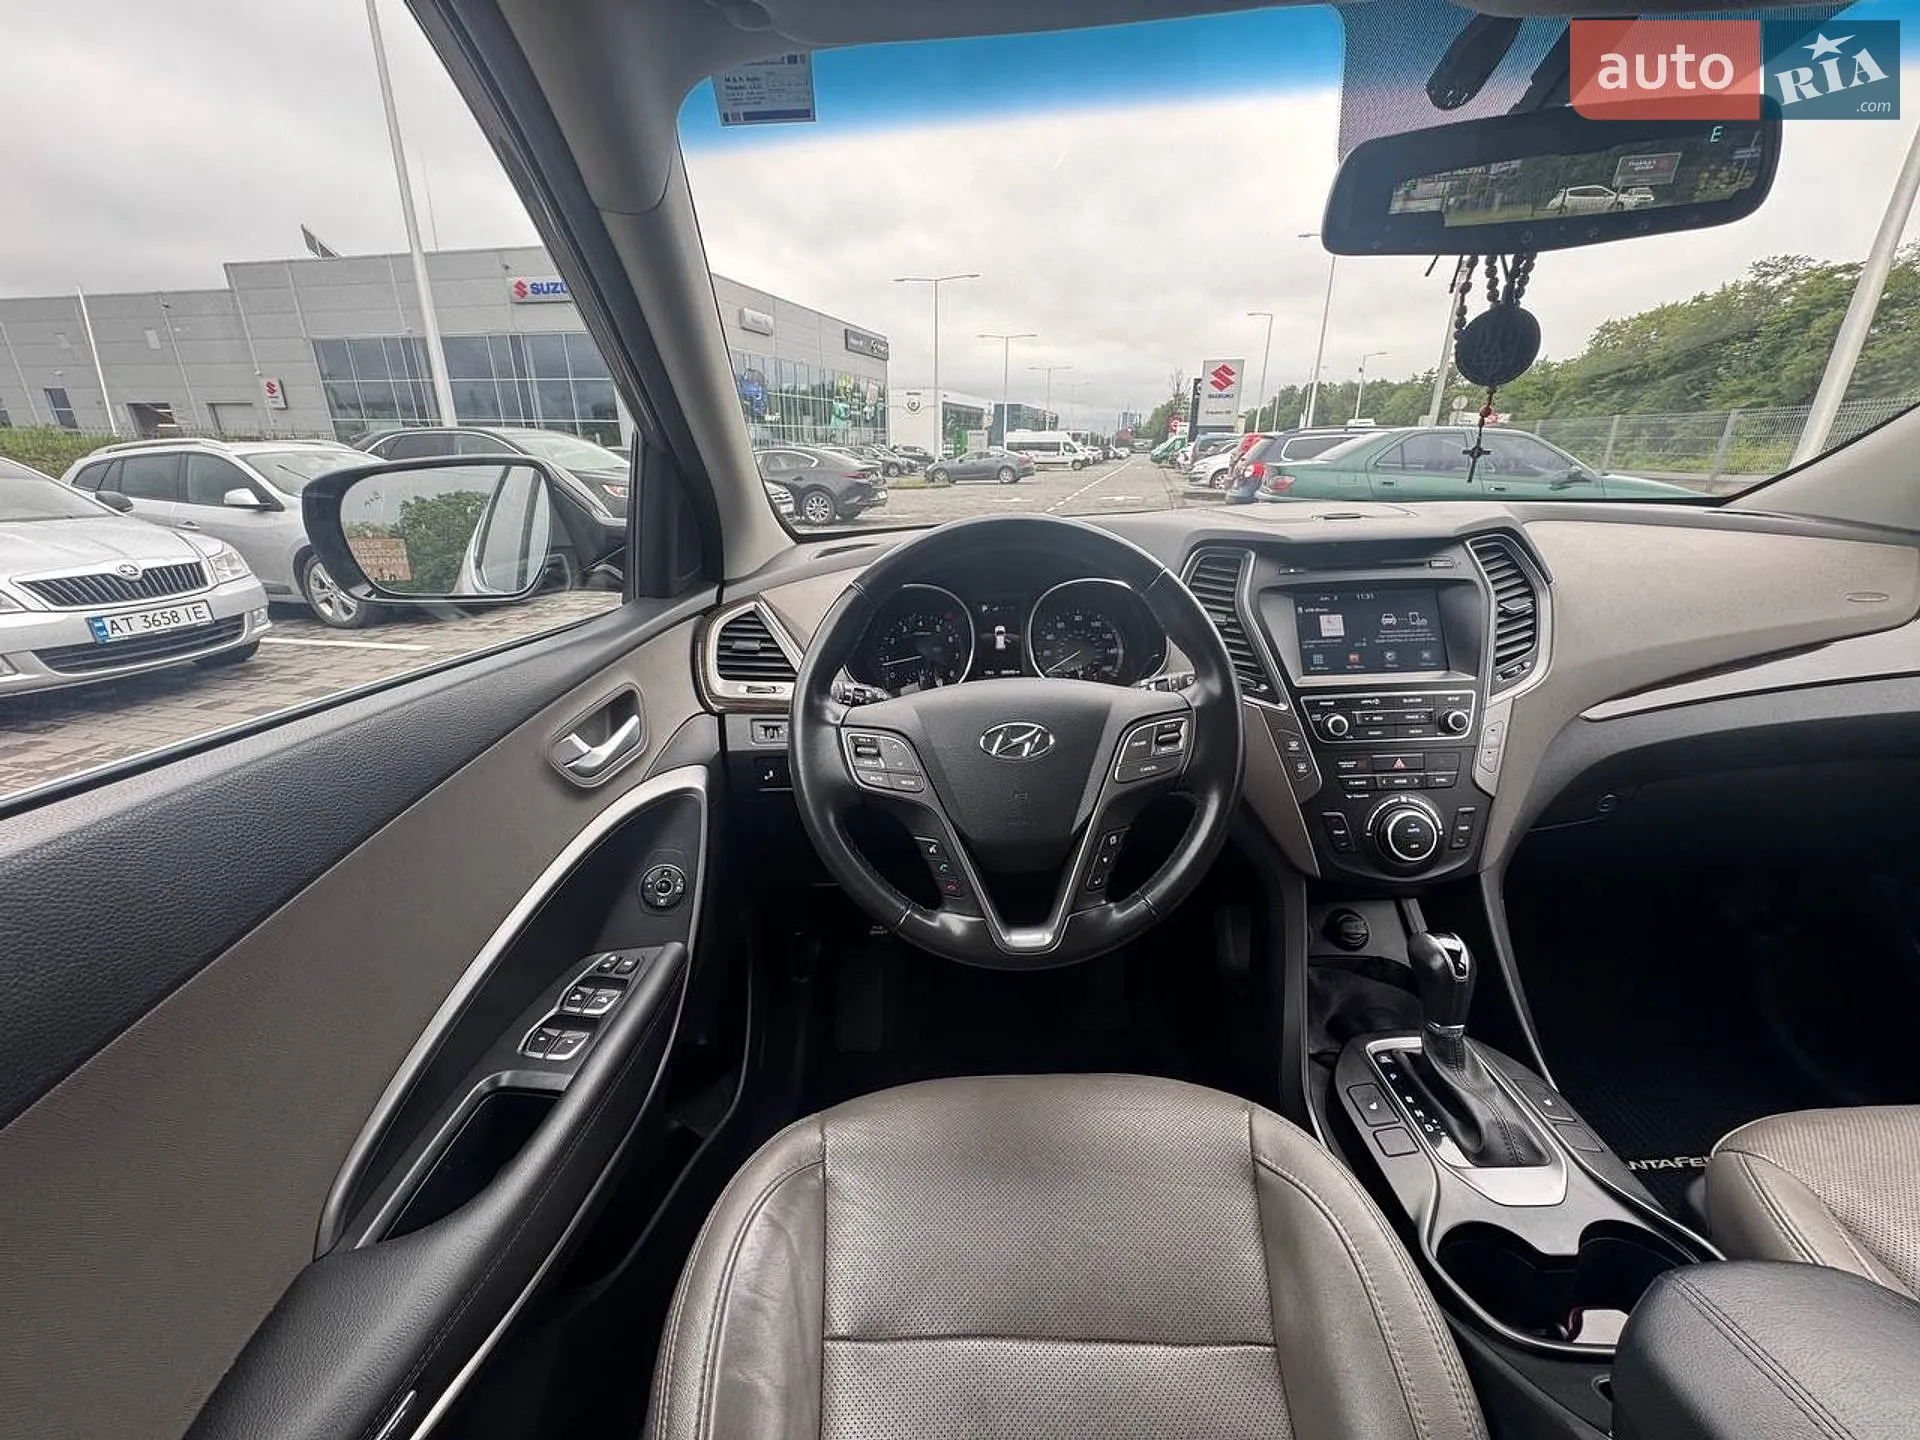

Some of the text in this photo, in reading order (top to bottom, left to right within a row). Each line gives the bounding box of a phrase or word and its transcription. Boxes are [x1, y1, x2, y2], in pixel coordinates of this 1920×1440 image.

[109, 605, 206, 635] AT 3658 IE
